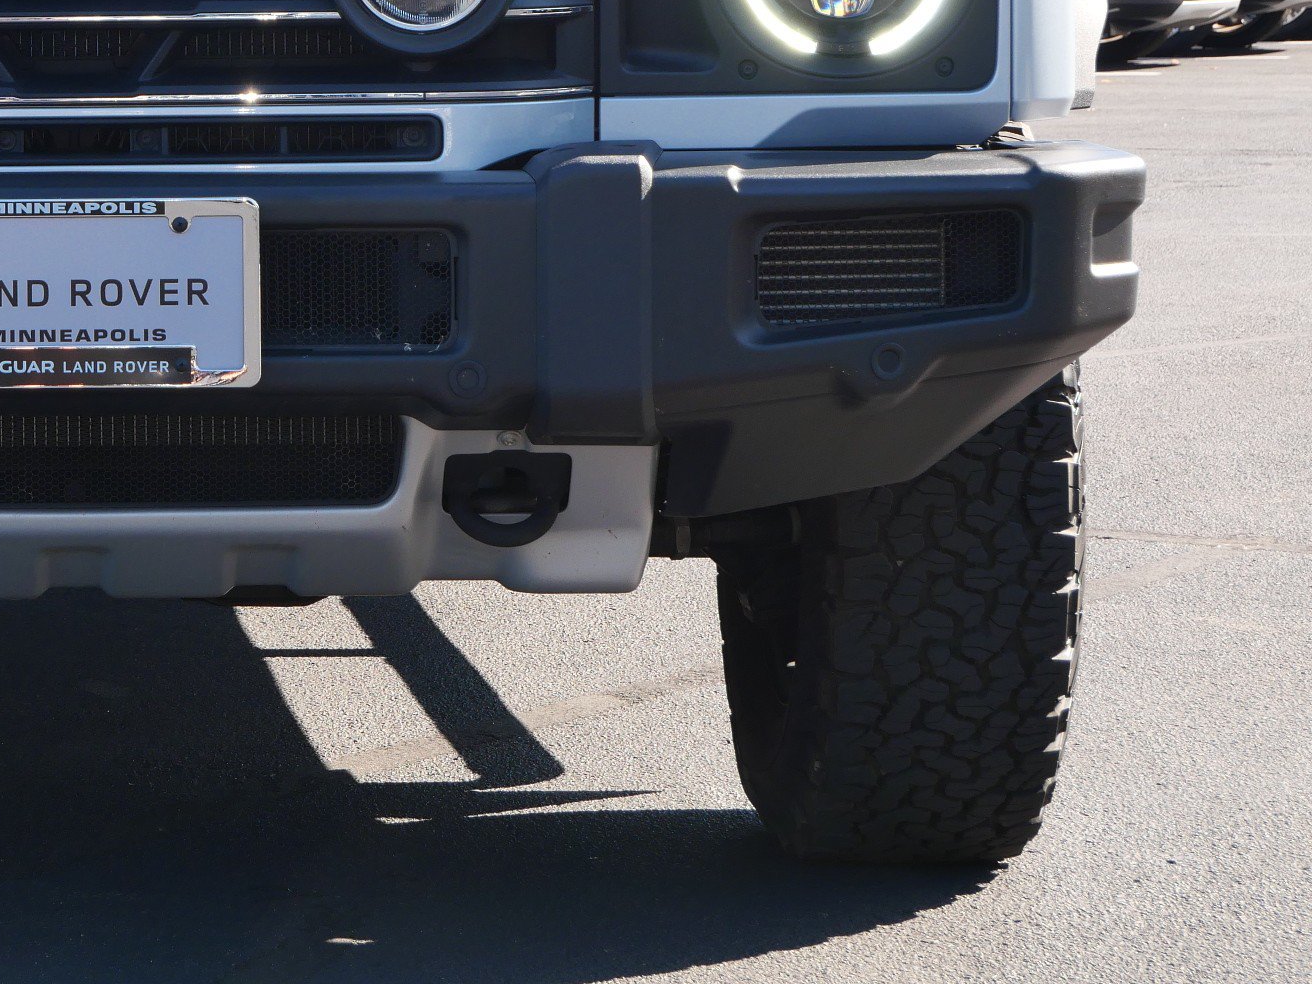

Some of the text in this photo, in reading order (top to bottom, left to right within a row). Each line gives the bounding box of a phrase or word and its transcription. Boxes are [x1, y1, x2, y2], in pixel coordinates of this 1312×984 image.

[70, 278, 211, 307] ROVER
[63, 361, 107, 374] LAND
[114, 360, 170, 373] ROVER
